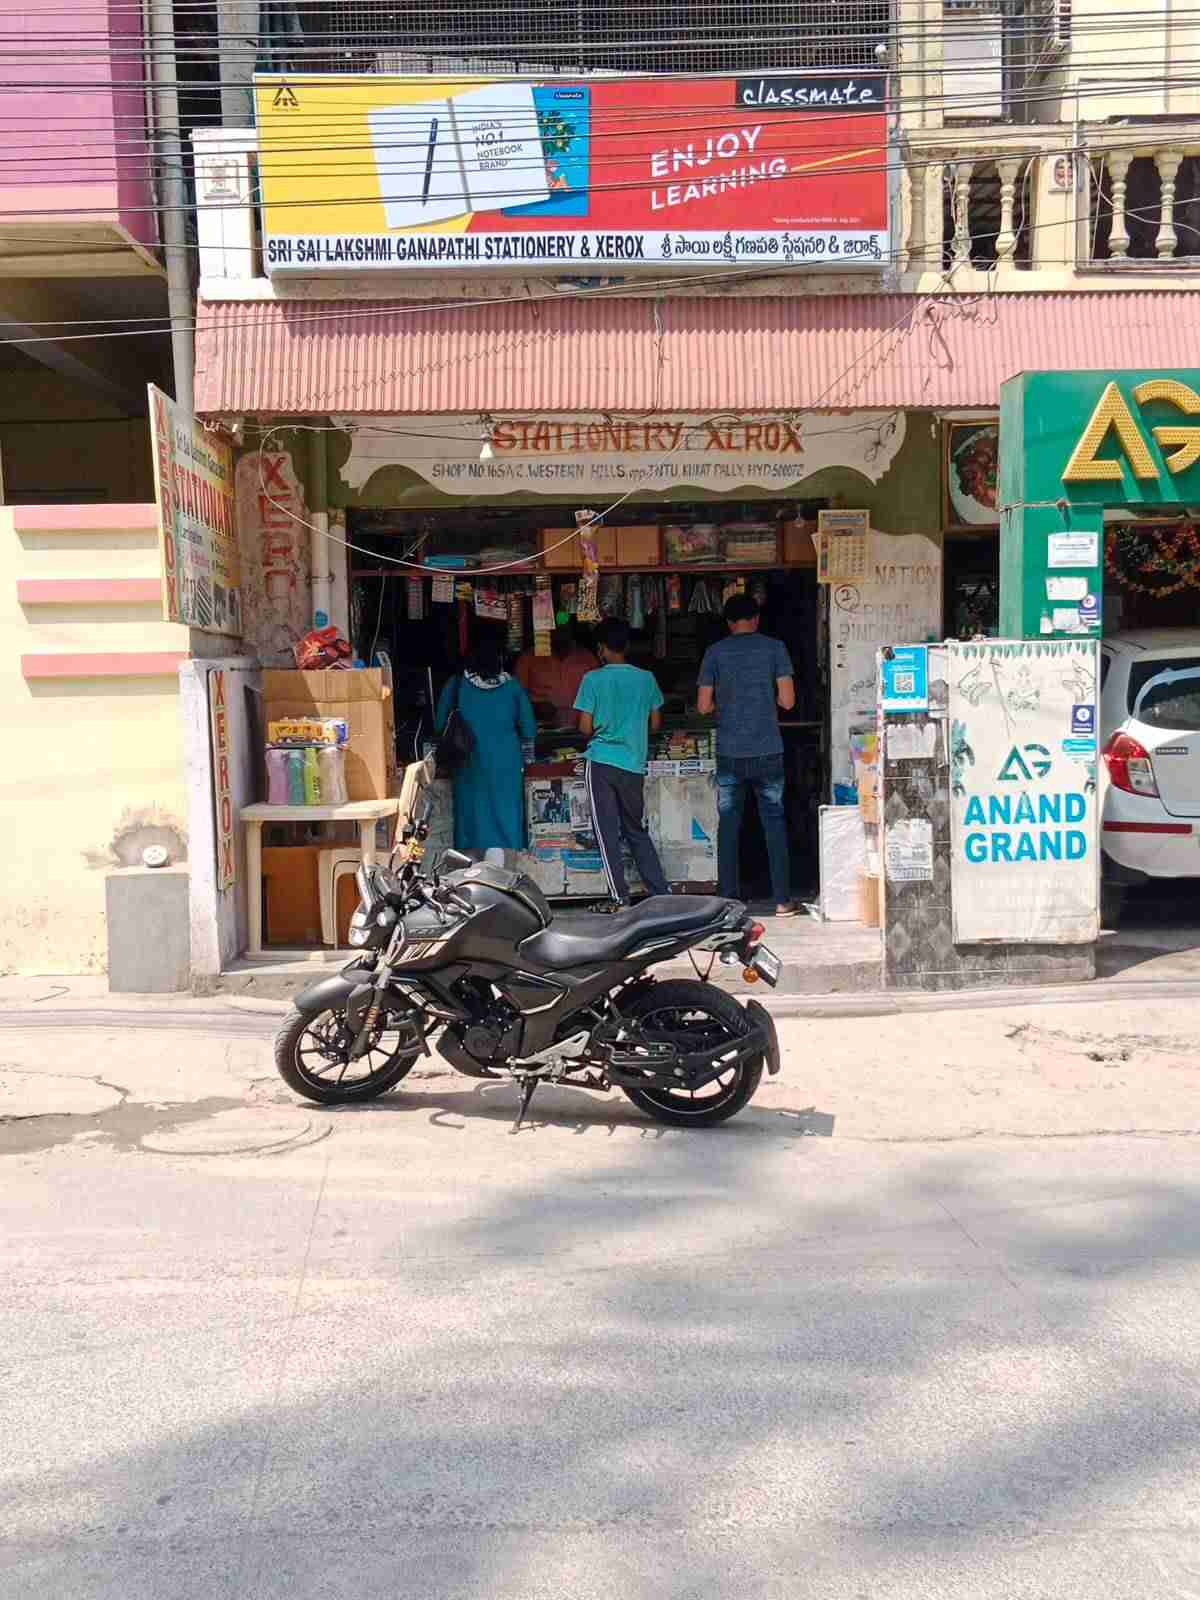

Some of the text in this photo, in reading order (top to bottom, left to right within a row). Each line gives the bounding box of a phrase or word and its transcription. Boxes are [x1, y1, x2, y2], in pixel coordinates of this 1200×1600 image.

[743, 80, 875, 105] classmate
[477, 144, 523, 160] NOTEBOOK
[651, 126, 762, 177] ENJOY
[651, 158, 788, 211] LEARNING
[268, 235, 645, 262] SRI SAI LAKSHMI GANAPATHI STATIONERY & XEROX
[874, 564, 938, 585] NATION
[213, 671, 233, 877] XEROX
[964, 792, 1087, 825] ANAND
[965, 830, 1087, 863] GRAND
